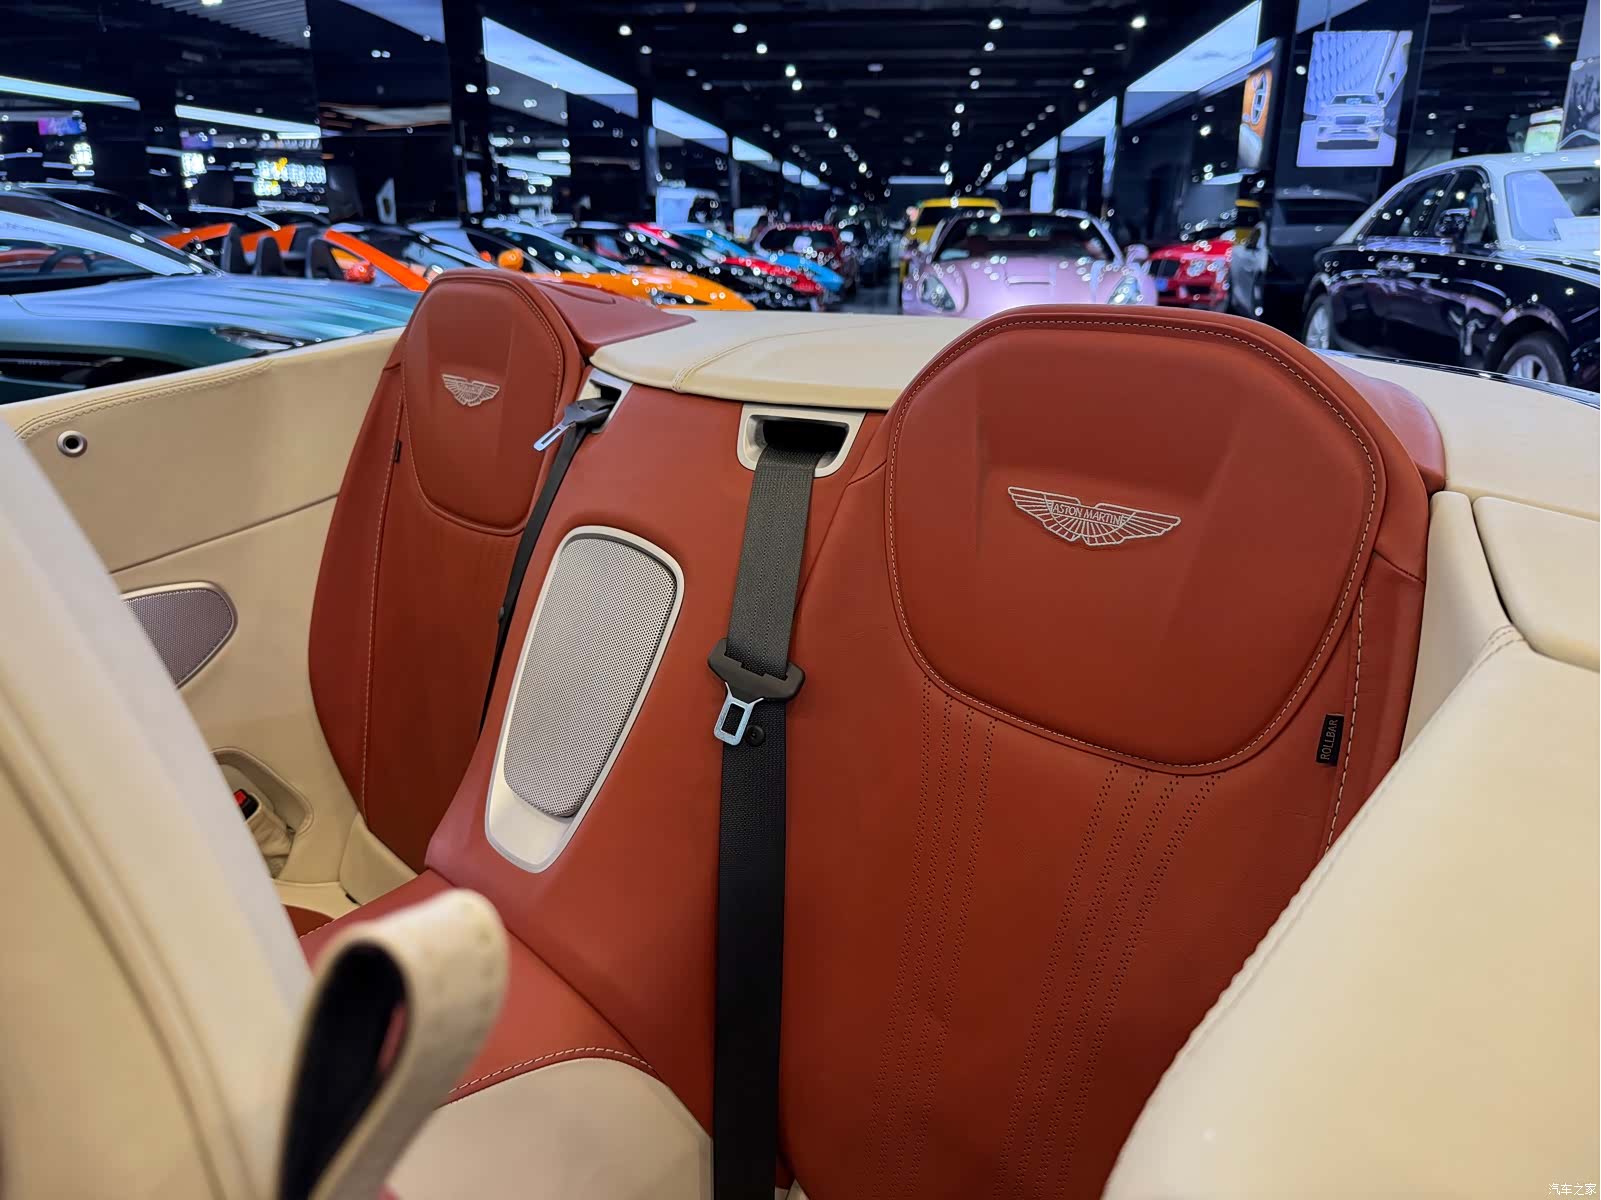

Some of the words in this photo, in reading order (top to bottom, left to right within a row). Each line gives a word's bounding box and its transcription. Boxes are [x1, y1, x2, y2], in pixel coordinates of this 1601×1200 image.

[1053, 503, 1082, 517] ASTON
[1083, 508, 1121, 525] MARTIN
[1320, 719, 1338, 761] ROLLBAR
